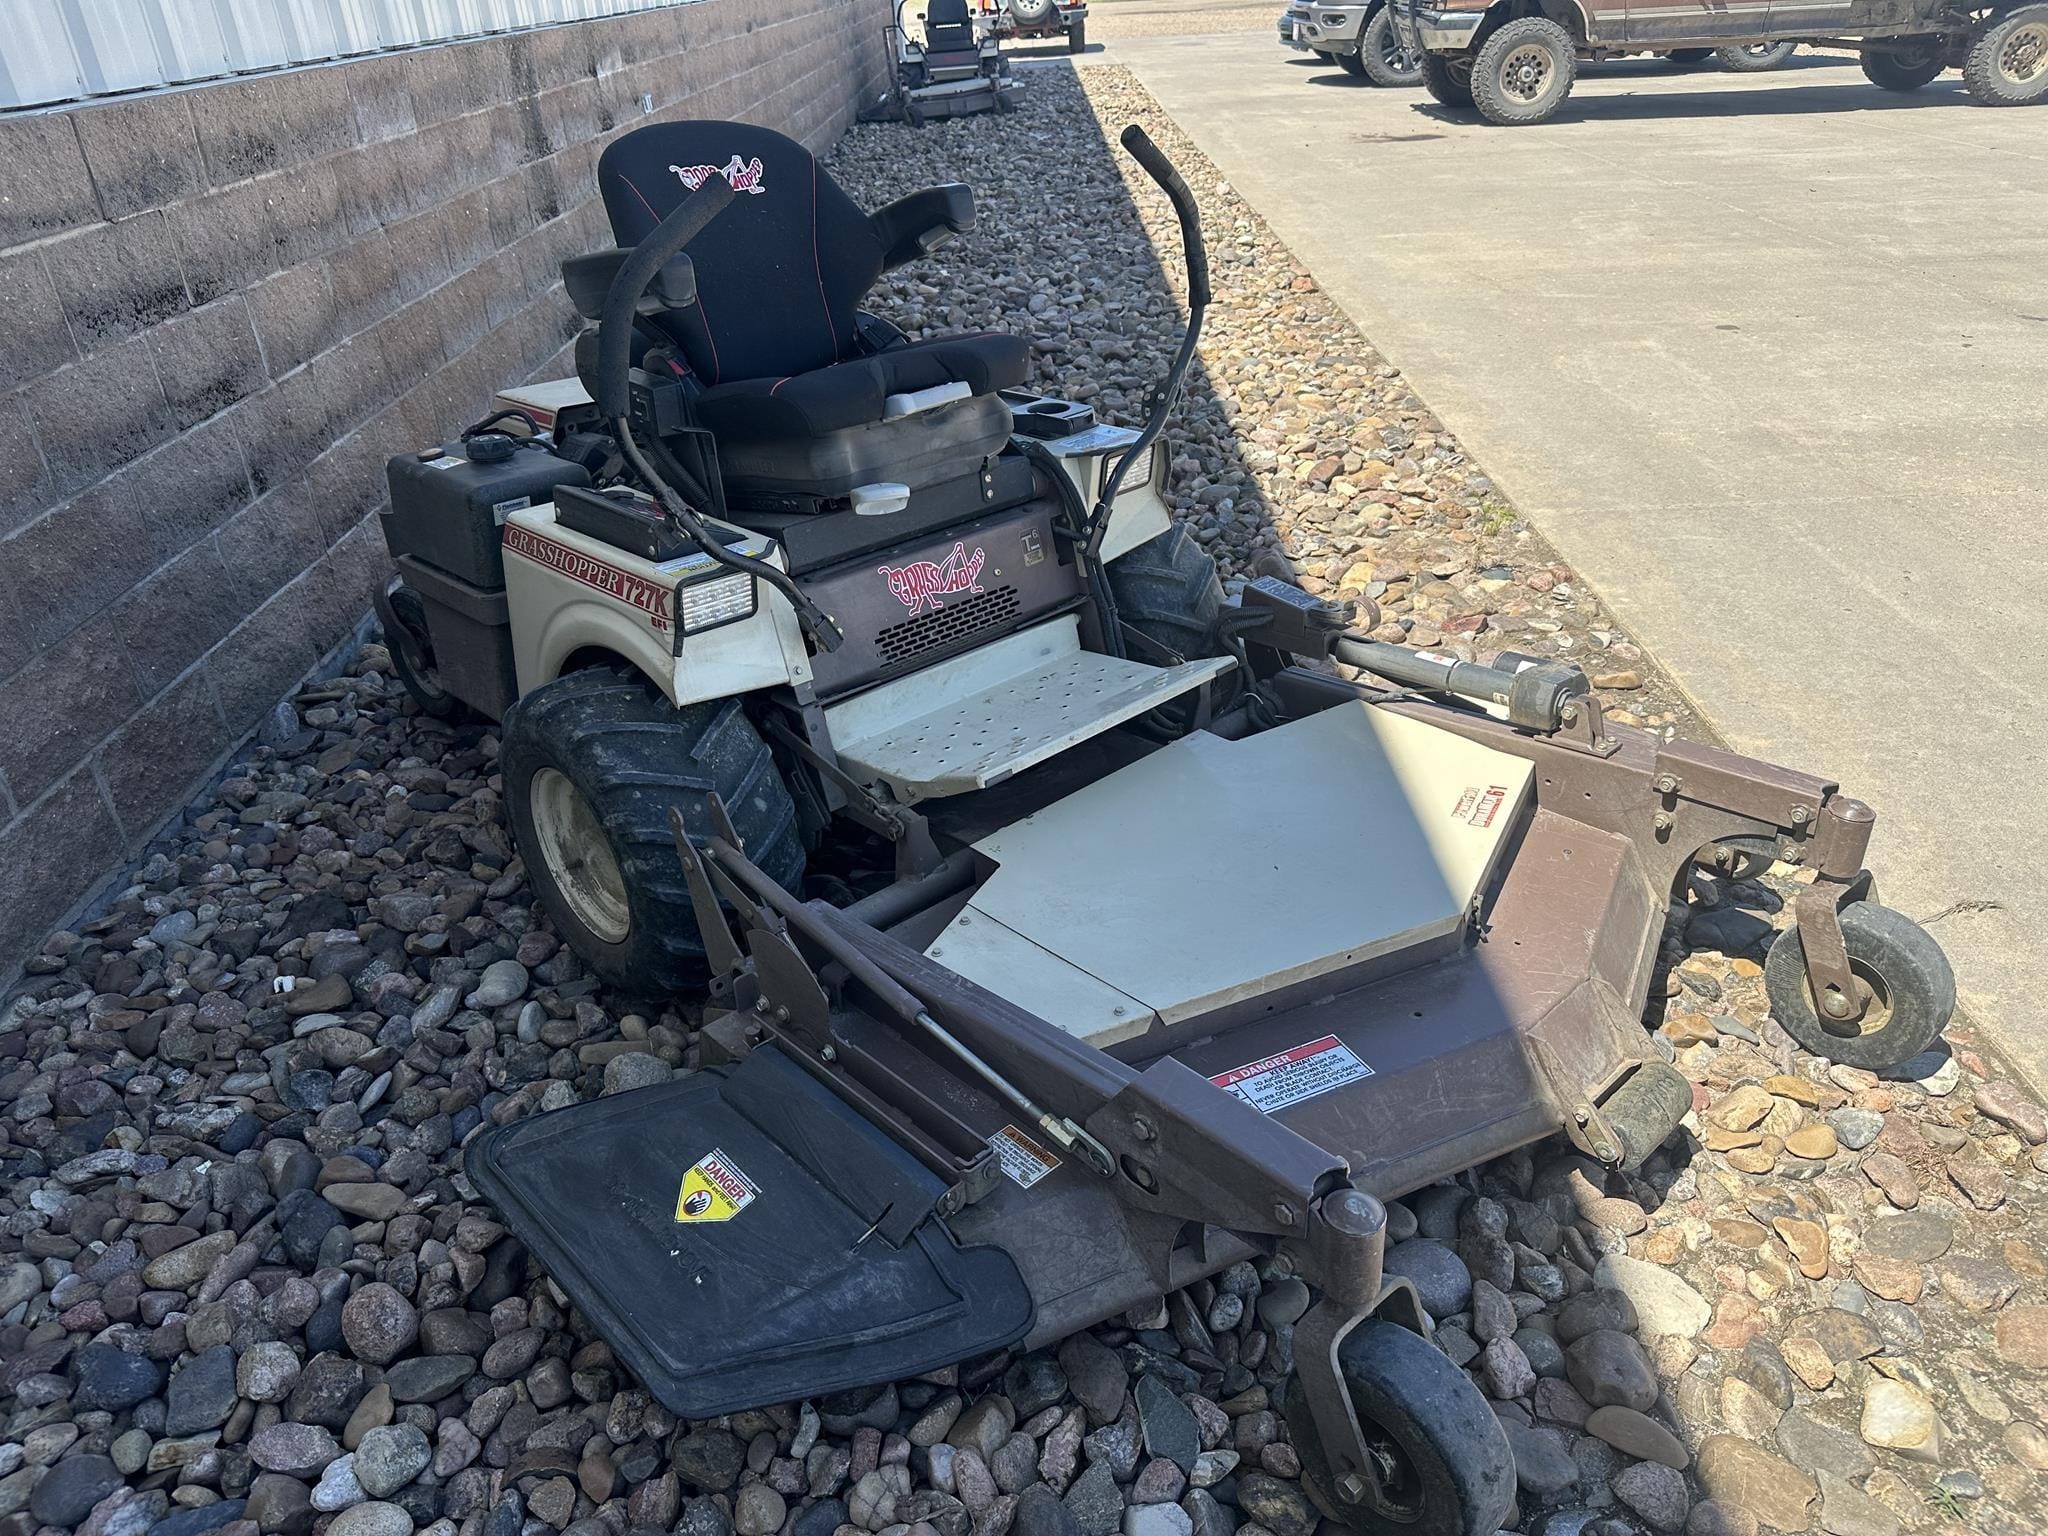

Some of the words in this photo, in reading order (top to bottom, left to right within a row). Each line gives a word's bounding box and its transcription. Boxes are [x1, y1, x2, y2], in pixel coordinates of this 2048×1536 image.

[508, 529, 619, 592] GRASSHOPPER
[624, 575, 668, 617] 727K
[1240, 1054, 1292, 1078] DANGER
[1263, 1073, 1284, 1083] AVOID
[1269, 1065, 1289, 1076] KEEP
[1254, 1082, 1275, 1093] DEATH
[1273, 1075, 1294, 1085] FROM
[1015, 1135, 1050, 1162] WARNING
[704, 1160, 746, 1201] DANGER
